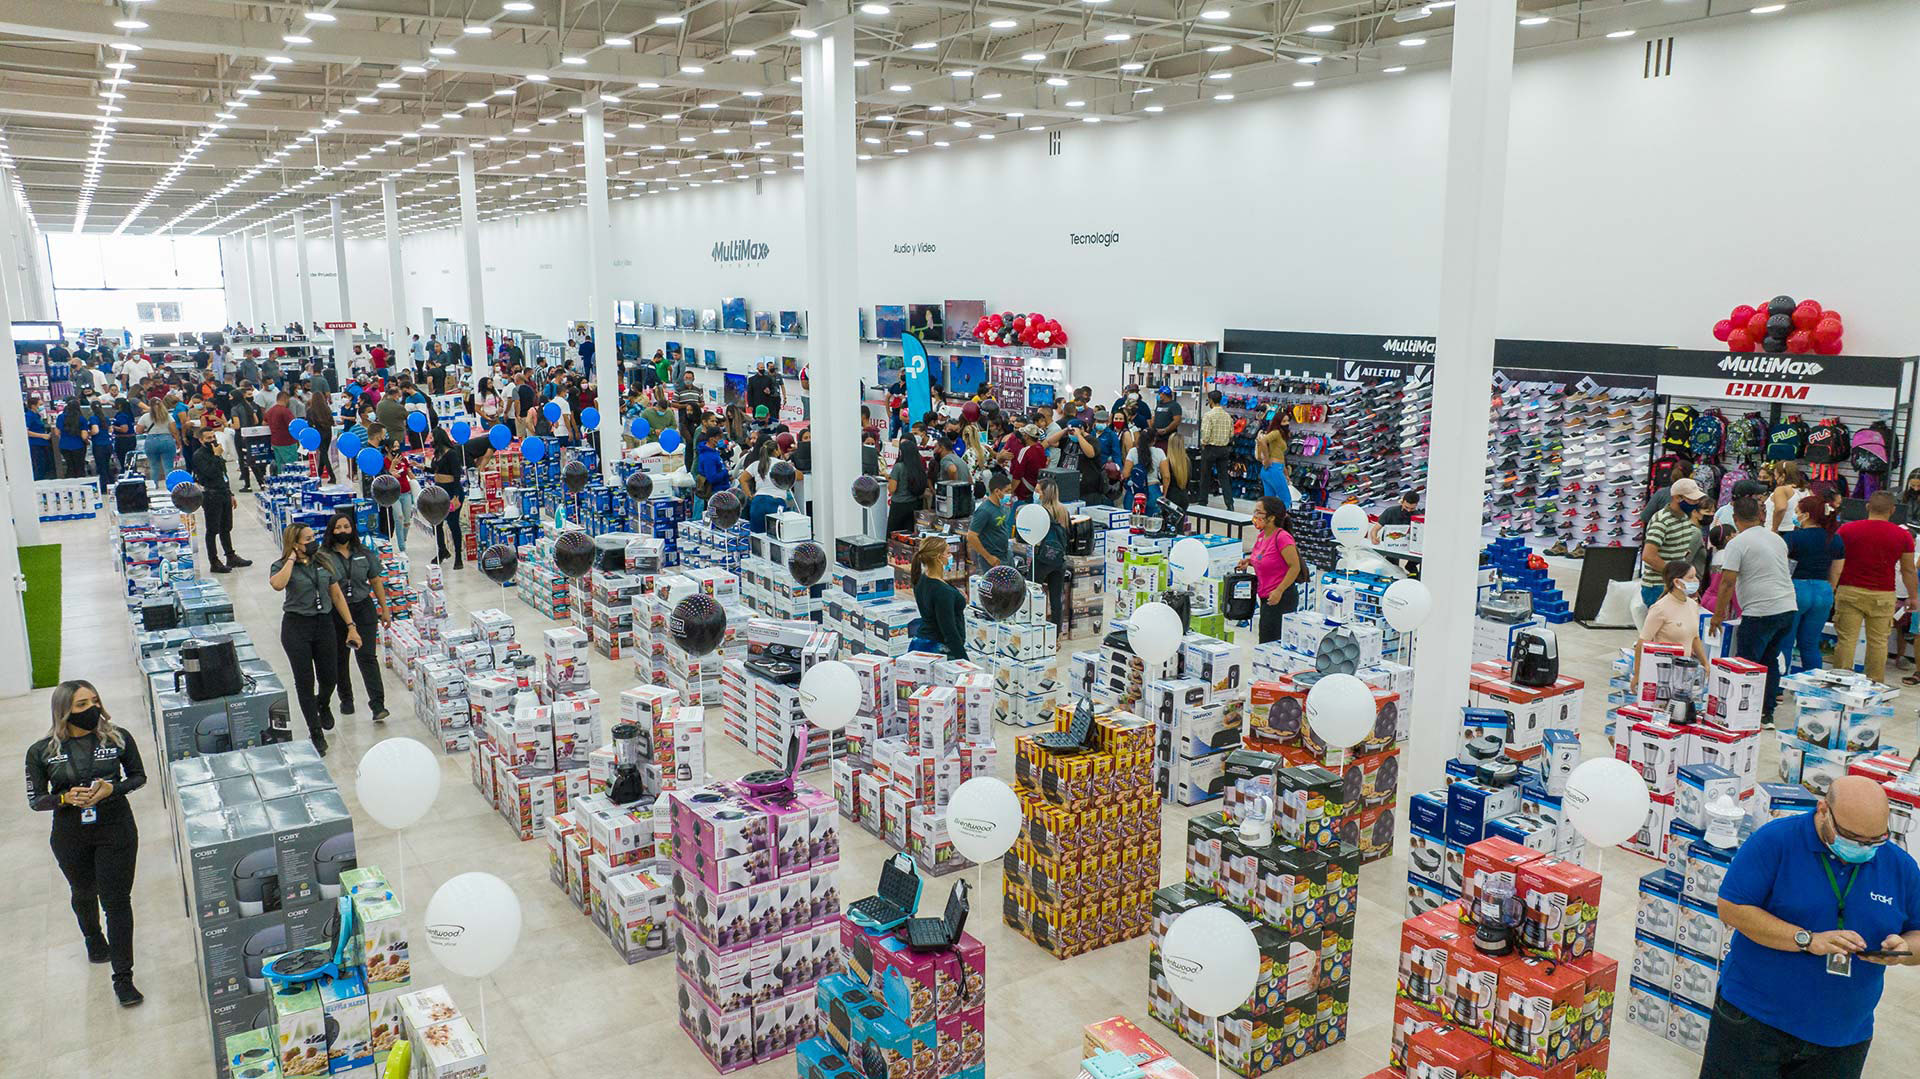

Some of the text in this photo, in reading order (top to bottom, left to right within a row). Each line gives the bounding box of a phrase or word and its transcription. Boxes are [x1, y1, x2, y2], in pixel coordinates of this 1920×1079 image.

[1069, 230, 1119, 247] Tecnología
[711, 239, 769, 263] MultiMax
[893, 243, 911, 254] Audio
[911, 246, 917, 256] y
[328, 322, 354, 330] aiwa
[1384, 339, 1436, 353] MultiMa
[1719, 355, 1818, 376] MultiMax
[1725, 383, 1811, 400] CROM
[1771, 428, 1797, 443] FILA
[1808, 428, 1832, 445] FILA
